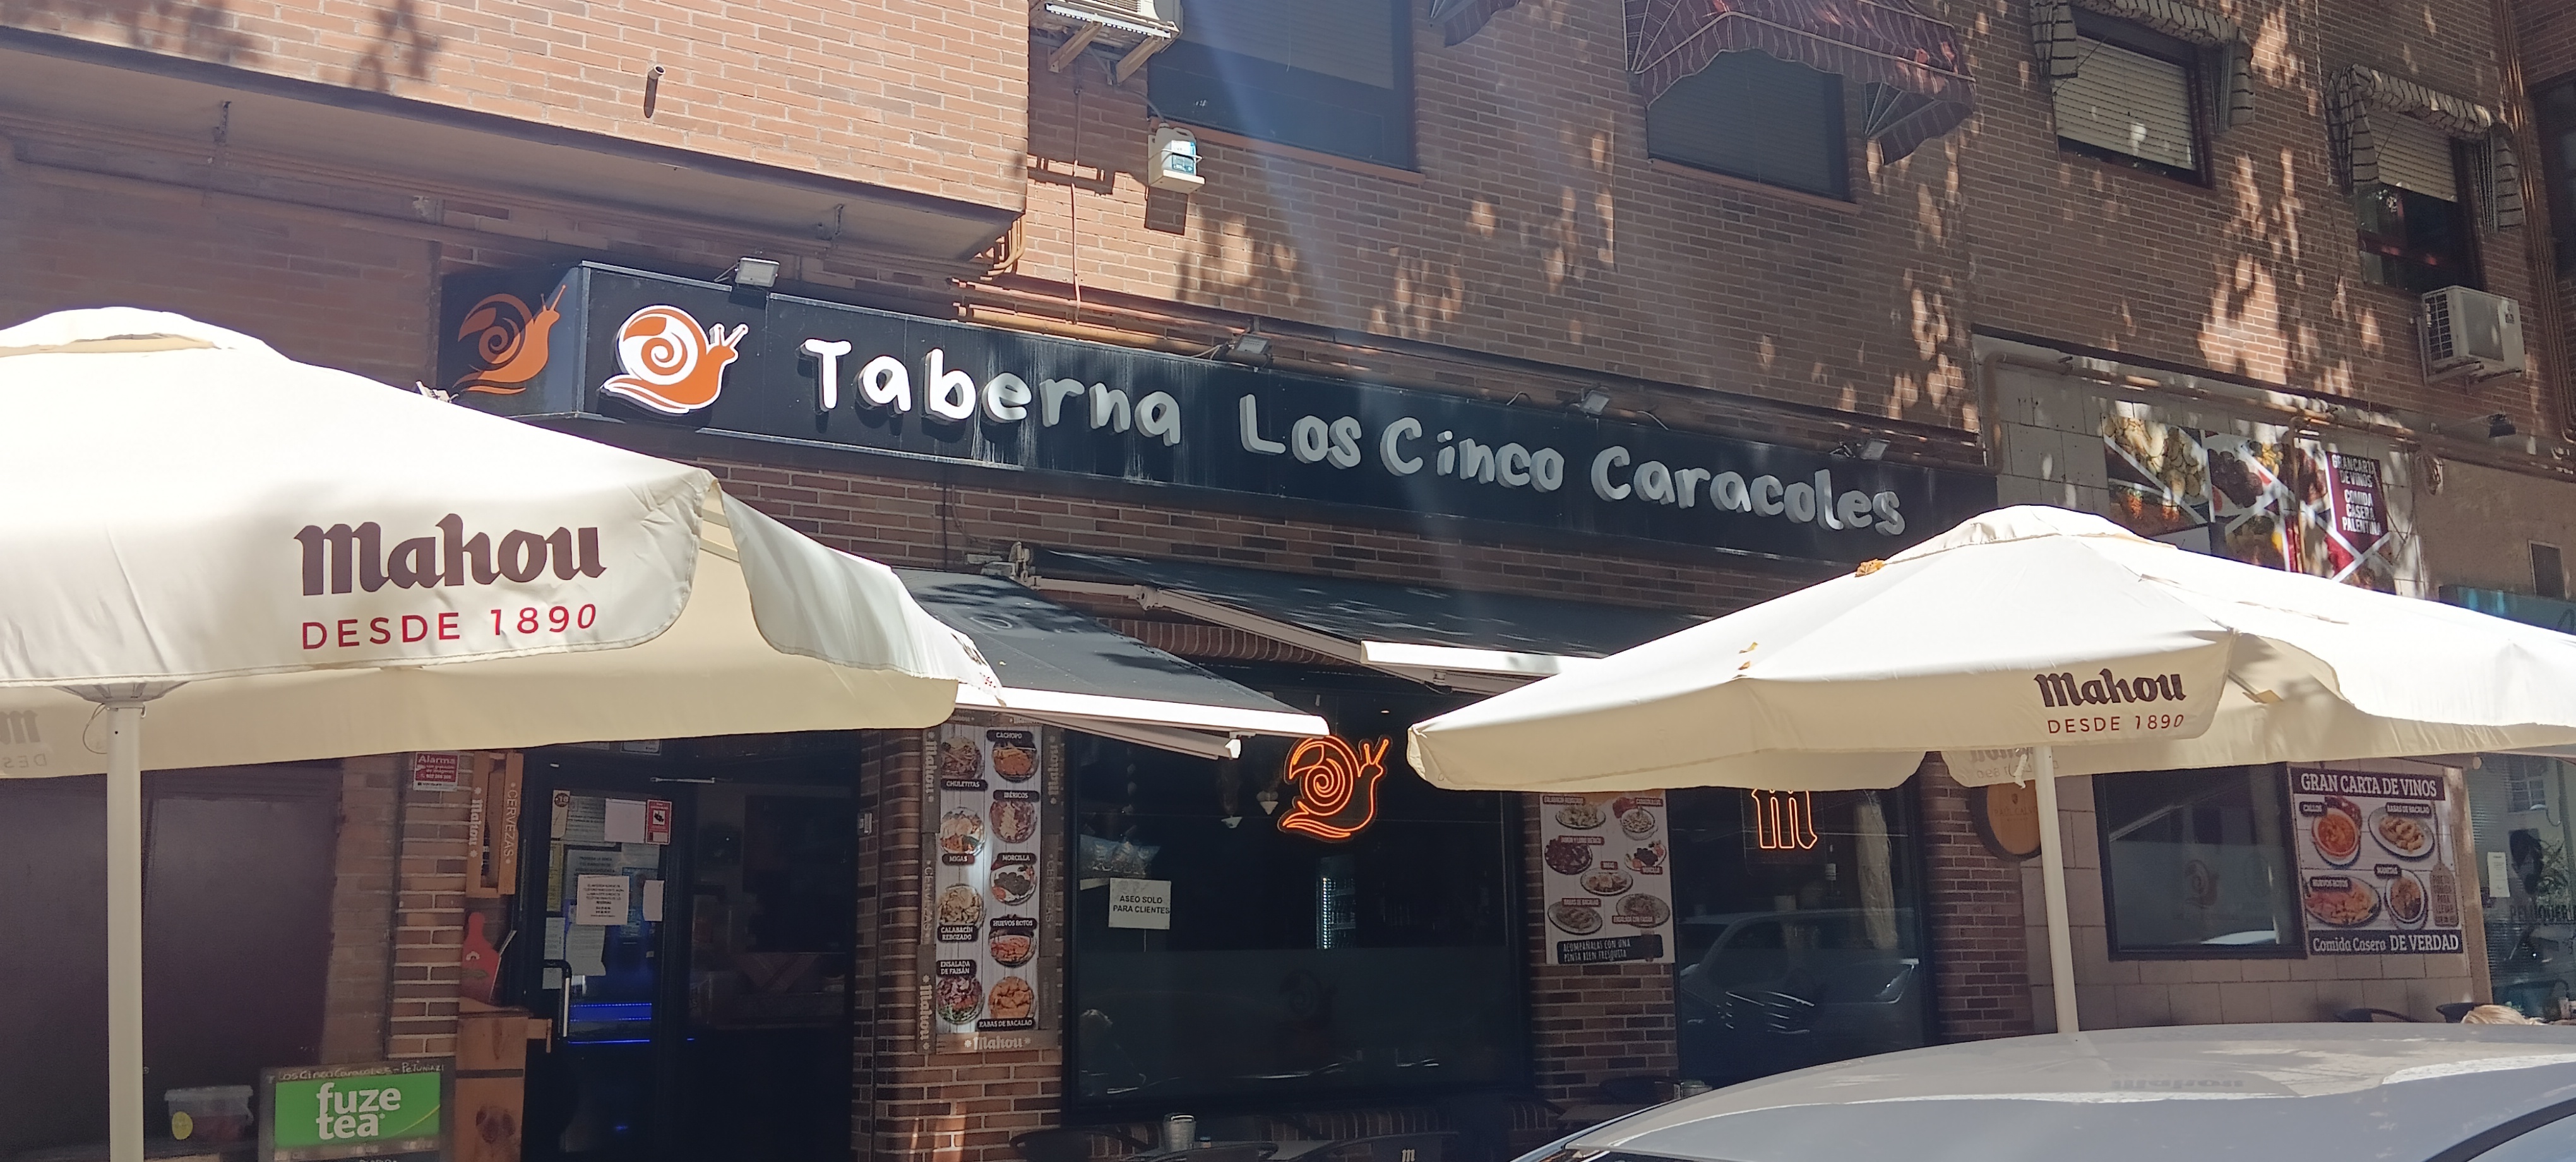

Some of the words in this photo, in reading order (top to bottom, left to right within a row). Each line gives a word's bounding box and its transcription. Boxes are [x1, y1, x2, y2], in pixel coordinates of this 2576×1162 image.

[799, 338, 1182, 446] Taberna
[1239, 393, 1362, 470] Los
[1379, 416, 1565, 493] Cinco
[1590, 445, 1906, 536] Caracoles
[2344, 489, 2374, 506] COMIDA
[2346, 503, 2376, 521] CASERA
[2341, 516, 2382, 535] PALENTINA
[292, 512, 607, 597] Mahou
[302, 611, 461, 650] DESDE
[490, 603, 597, 637] 1890
[2034, 668, 2187, 708] Mahou
[2047, 716, 2121, 734] DESDE
[2135, 714, 2186, 731] 1890
[418, 755, 456, 764] Alarma
[924, 740, 937, 795] Mahou
[2300, 772, 2339, 792] GRAN
[2340, 774, 2381, 794] CARTA
[2382, 777, 2399, 796] DE
[2401, 779, 2437, 797] VINOS
[2303, 805, 2323, 813] CALLOS
[468, 798, 484, 846] Mahou
[503, 789, 518, 858] CERVEZAS
[1135, 906, 1170, 914] CLIENTES
[1618, 938, 1631, 948] UNA
[2312, 937, 2351, 952] Comida
[2390, 935, 2407, 951] DE
[2410, 934, 2459, 951] VERDAD
[1564, 952, 1582, 962] PINTA
[1583, 951, 1597, 961] BIEN
[1598, 949, 1627, 962] FRESQUITA
[919, 984, 933, 1041] Mahou
[973, 1036, 1023, 1050] Mahou
[316, 1082, 402, 1115] fuze
[316, 1111, 379, 1141] tea
